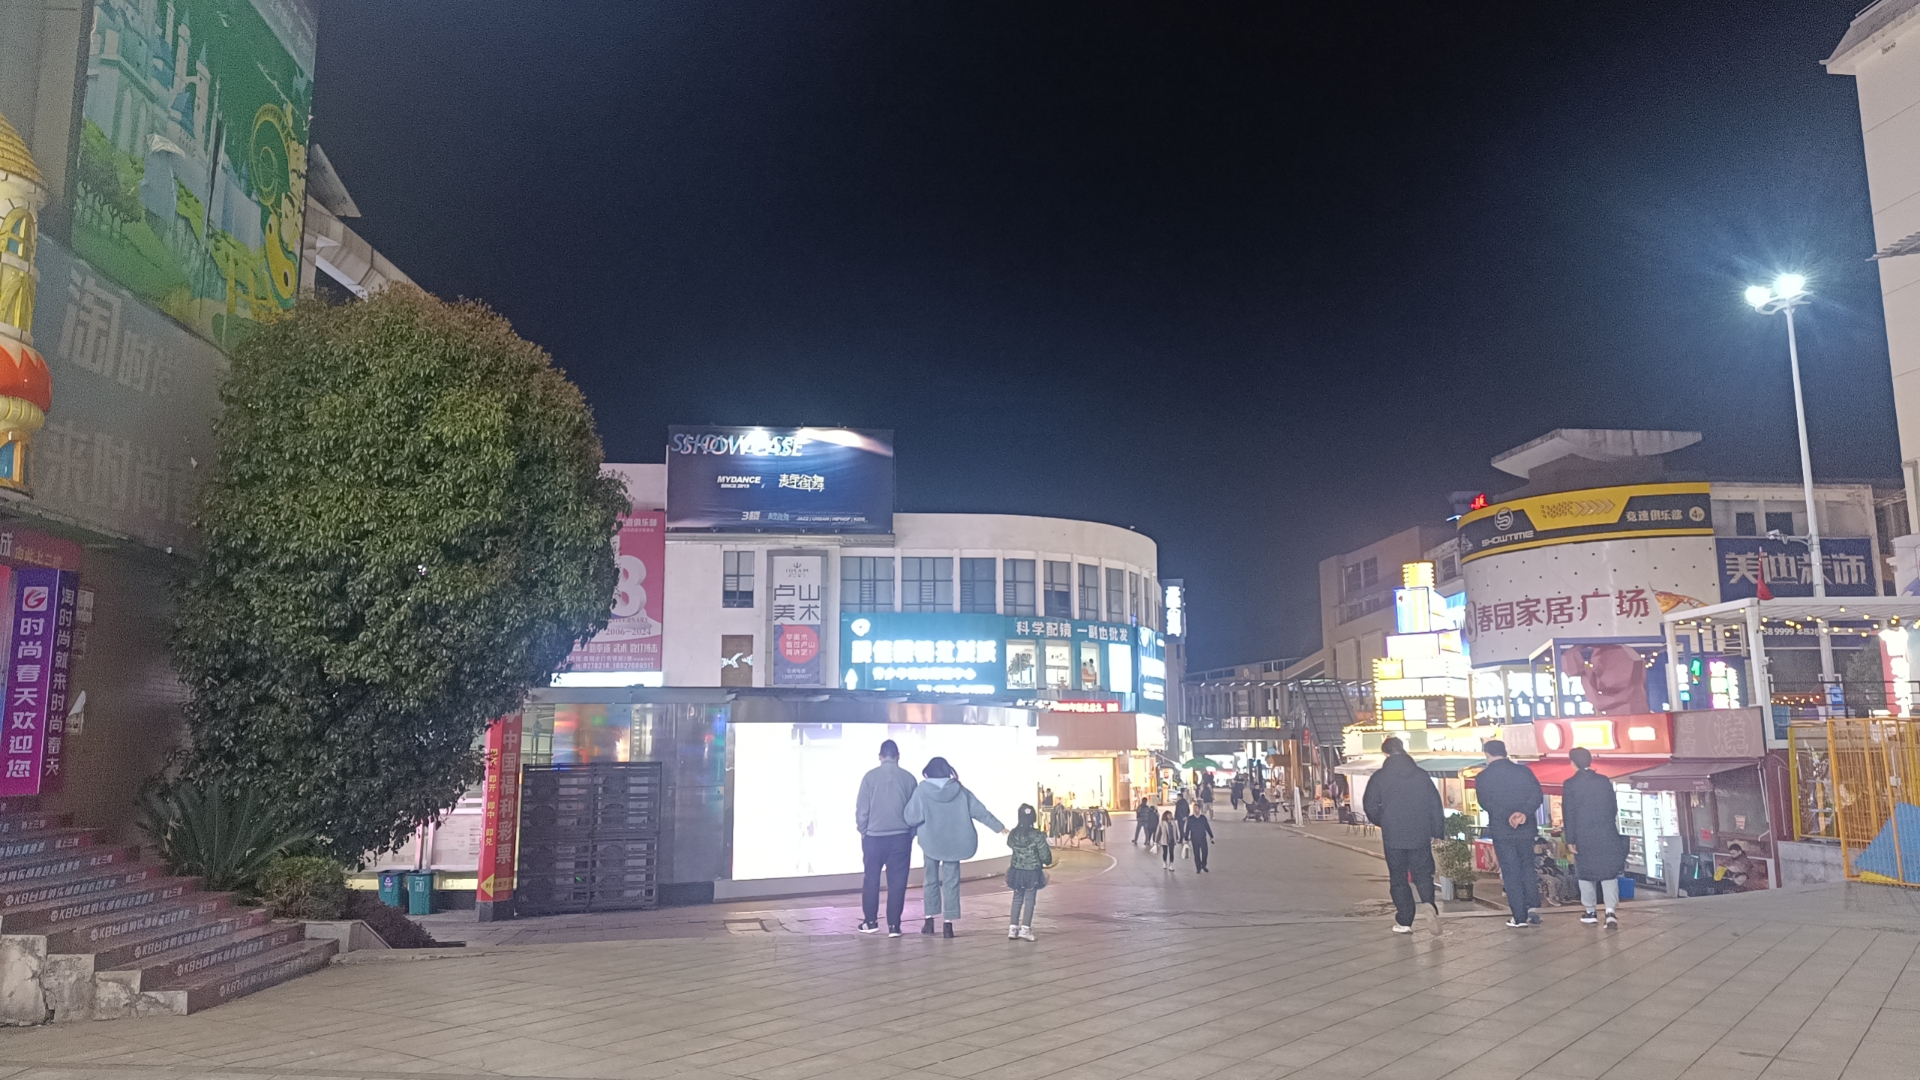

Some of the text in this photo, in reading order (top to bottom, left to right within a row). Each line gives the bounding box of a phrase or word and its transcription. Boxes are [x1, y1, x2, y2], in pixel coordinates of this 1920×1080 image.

[717, 475, 762, 484] MYDANCE
[1626, 510, 1682, 522] 竞速俱乐部
[1482, 530, 1534, 547] SHOWTIME
[774, 584, 820, 601] 卢山
[774, 604, 820, 621] 美术
[1477, 589, 1650, 632] 春园家居广场
[1016, 620, 1128, 642] 科学配镜 一副也批发
[1774, 628, 1794, 636] 9999
[45, 586, 75, 776] 淘时尚就来时尚春天
[6, 617, 45, 778] 时尚春天欢迎您
[496, 730, 518, 864] 中国福利彩票
